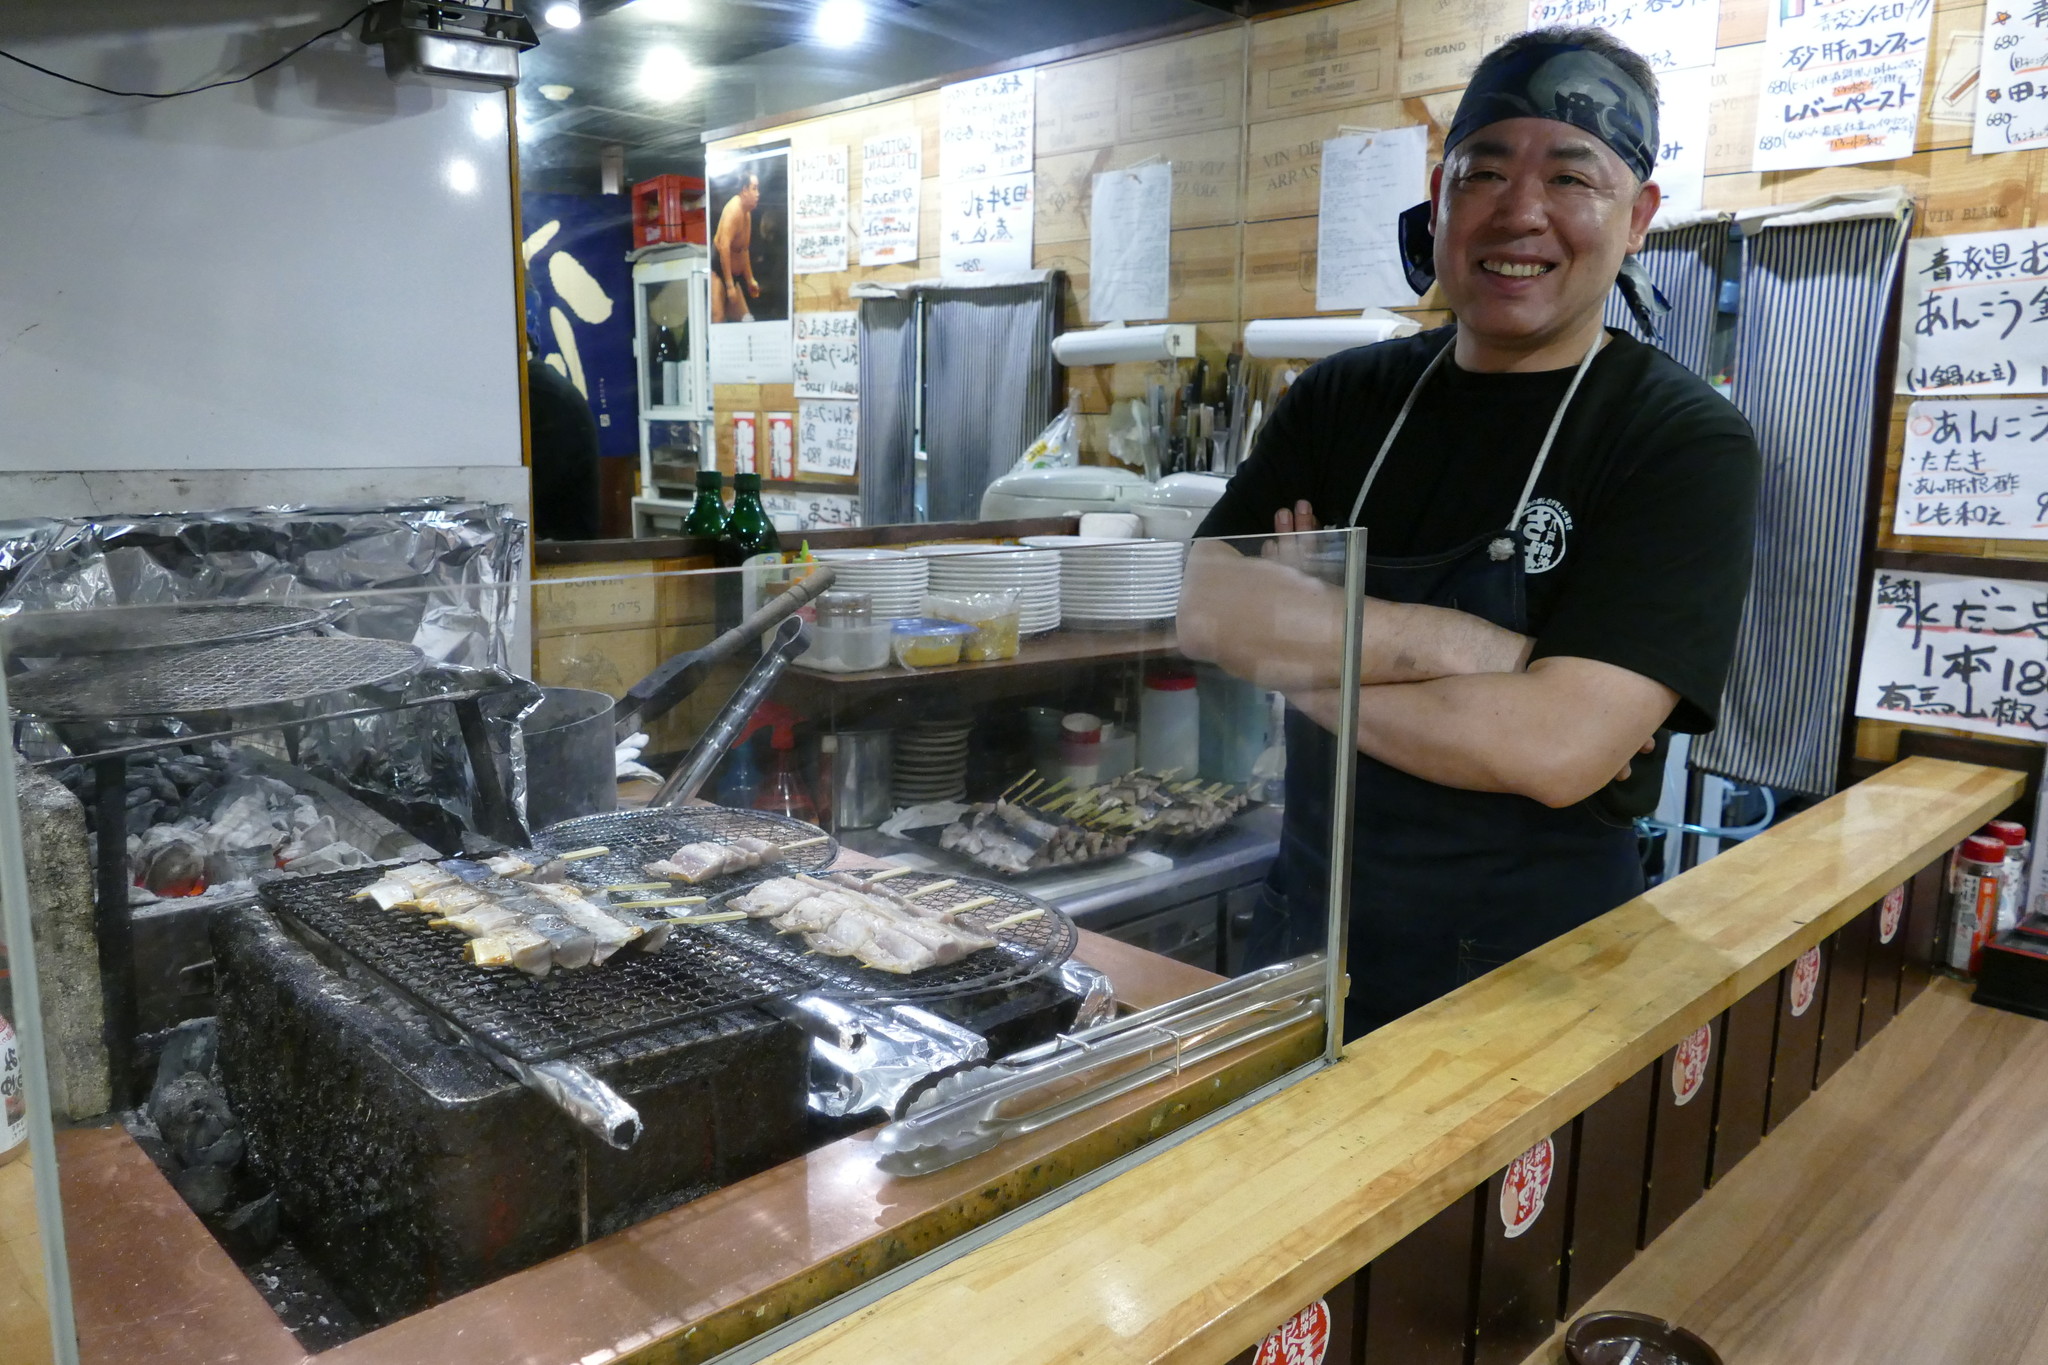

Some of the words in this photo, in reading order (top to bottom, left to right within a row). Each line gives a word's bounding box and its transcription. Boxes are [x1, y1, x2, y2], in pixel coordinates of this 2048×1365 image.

[1425, 42, 1466, 58] GRAND
[1784, 83, 1915, 123] レバーペースト
[1929, 212, 1955, 223] VIN
